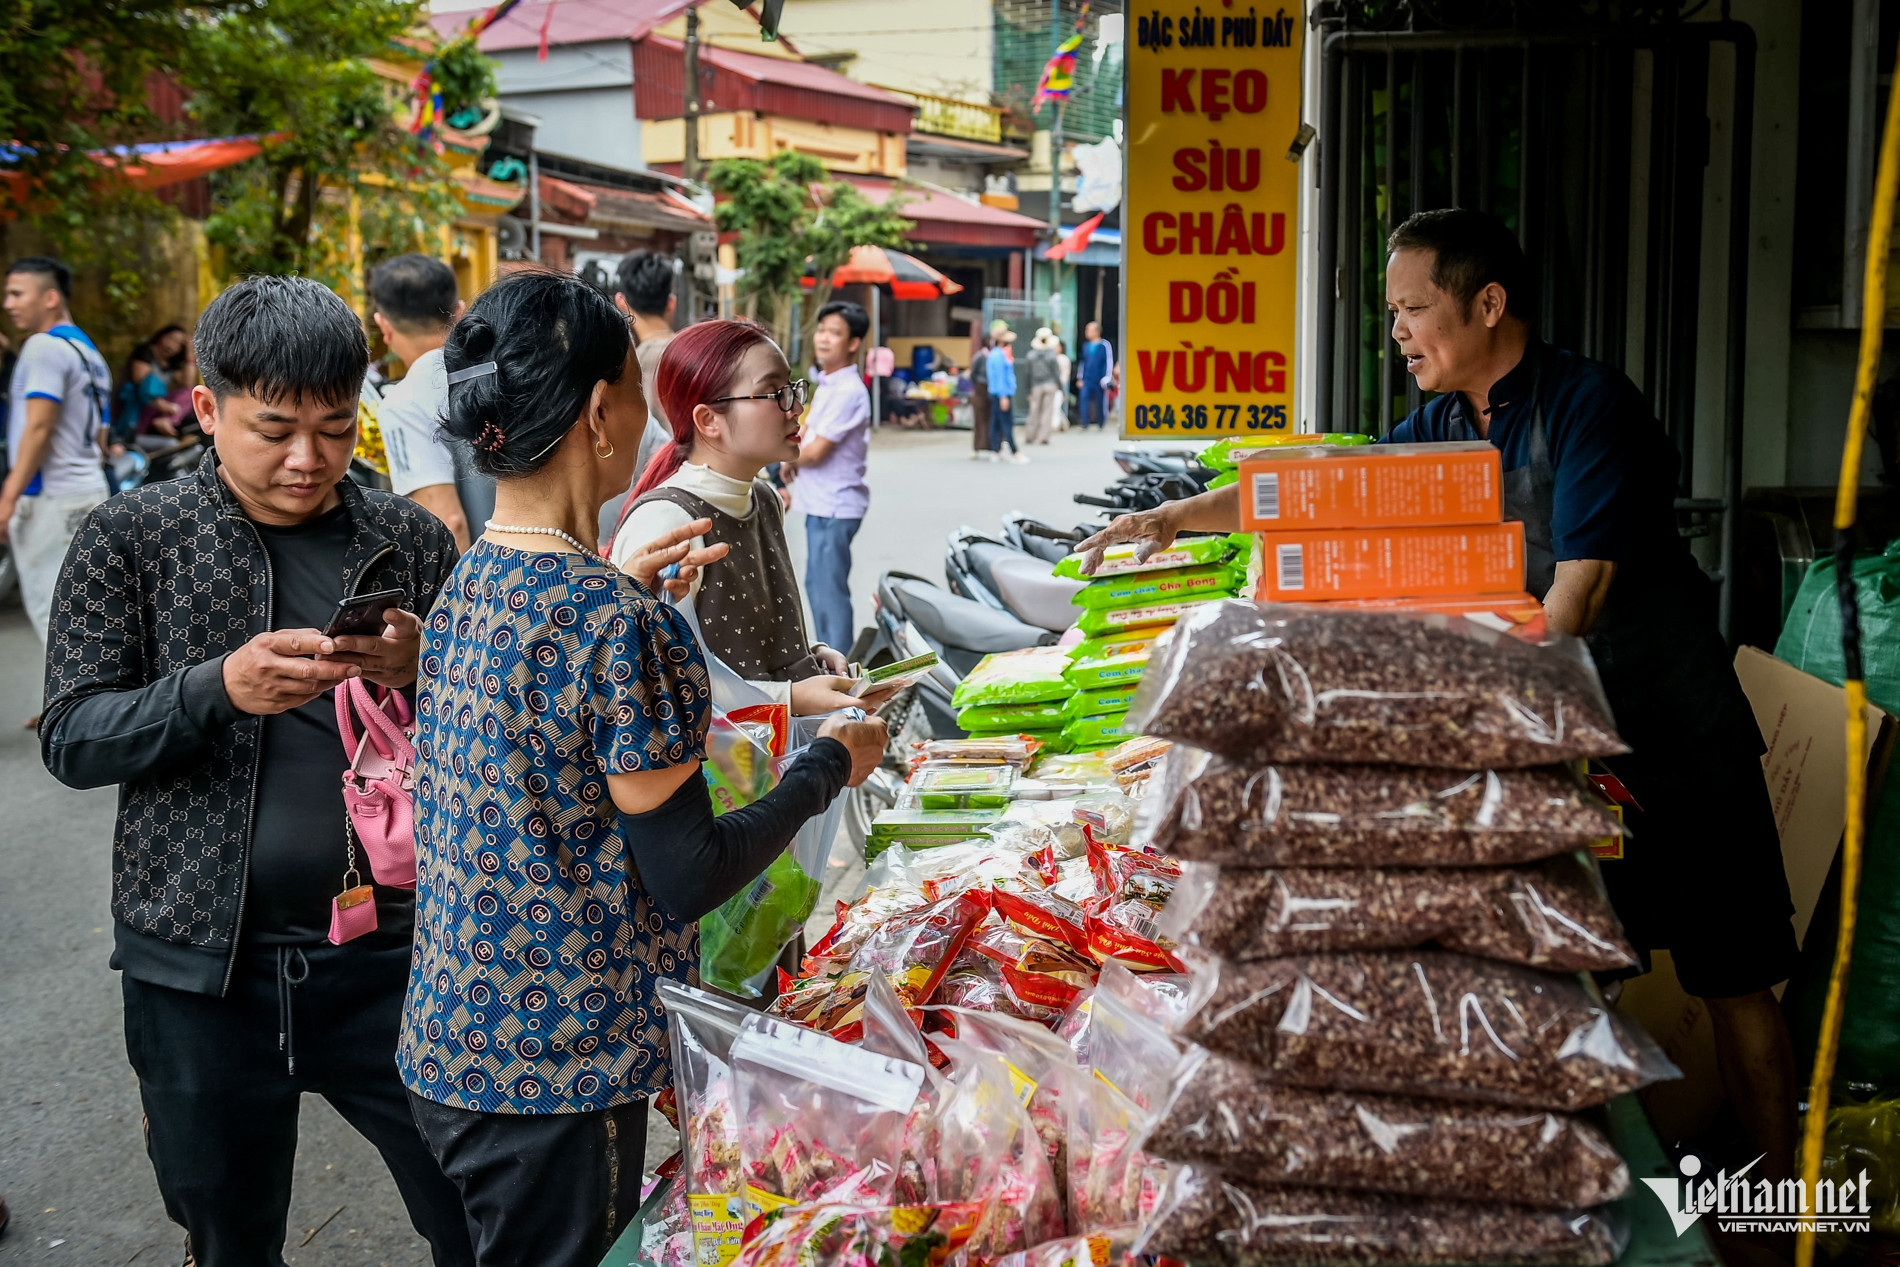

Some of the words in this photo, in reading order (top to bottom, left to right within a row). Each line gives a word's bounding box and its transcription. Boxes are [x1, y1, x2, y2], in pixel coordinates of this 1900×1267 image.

[1138, 10, 1173, 53] ĐẶC
[1179, 6, 1215, 47] SẢN
[1222, 6, 1256, 47] PHỦ
[1161, 68, 1268, 121] KẸO
[1172, 139, 1261, 192] SÌU
[1143, 203, 1286, 255] CHÂU
[1169, 267, 1256, 324] DỒI
[1136, 340, 1286, 393] VỪNG
[1135, 404, 1175, 429] 034
[1181, 404, 1207, 429] 36
[1214, 404, 1241, 429] 77
[1247, 404, 1286, 429] 325
